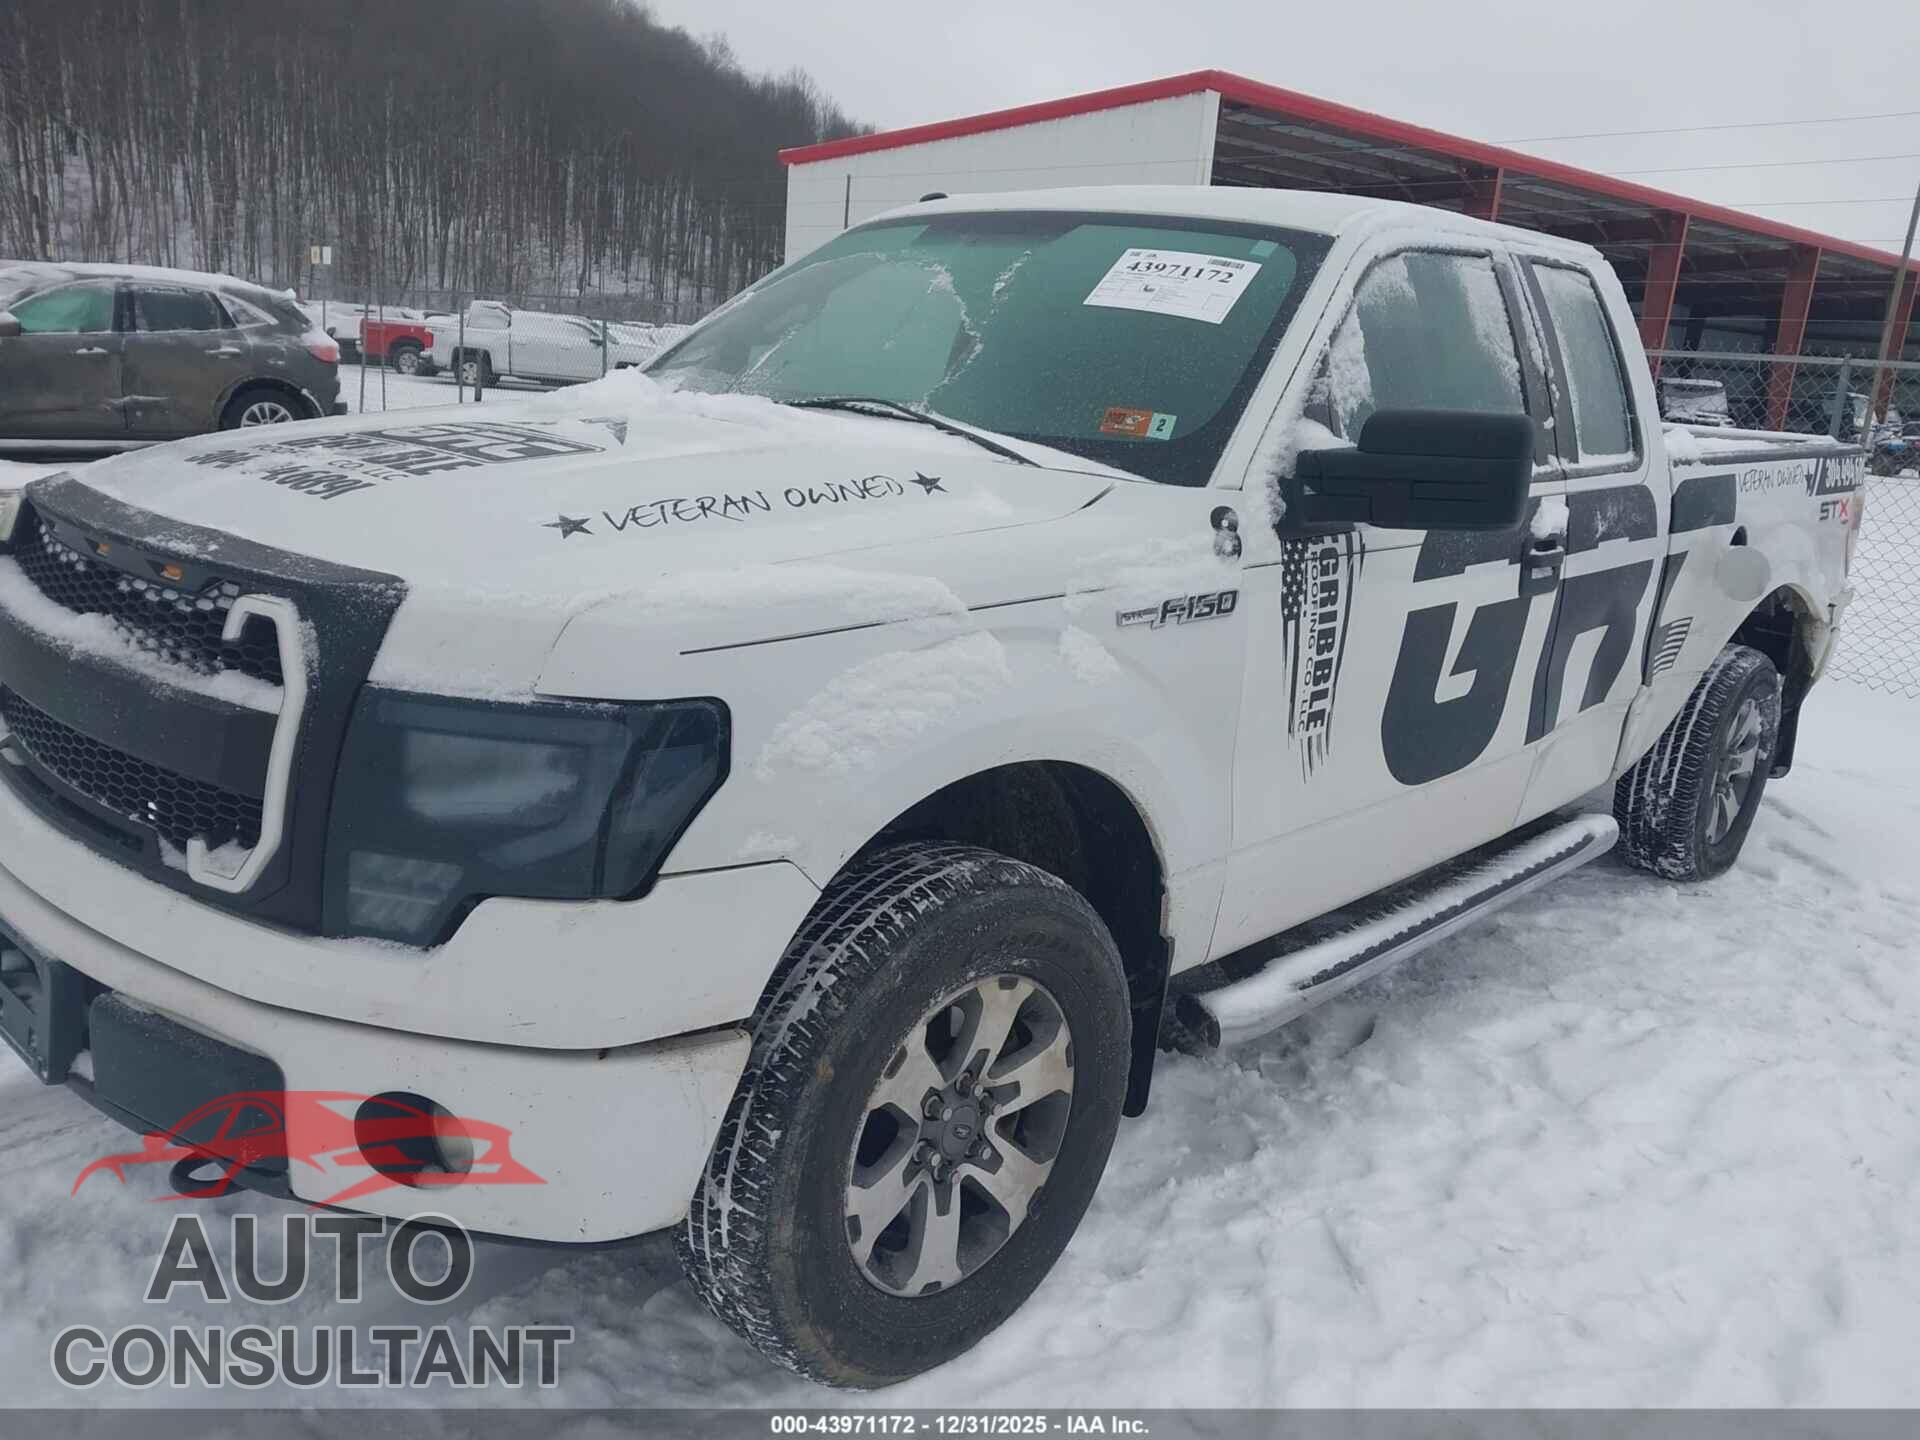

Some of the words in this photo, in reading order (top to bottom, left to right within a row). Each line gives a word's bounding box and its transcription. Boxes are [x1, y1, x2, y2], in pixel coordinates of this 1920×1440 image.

[1126, 261, 1234, 284] 43971172
[1156, 418, 1168, 432] 2
[277, 434, 484, 476] GRIBLE
[362, 468, 408, 480] LLC
[1738, 468, 1774, 495] VETERAN
[602, 489, 772, 532] VETERAN
[783, 475, 904, 508] OWNED
[1819, 500, 1849, 522] STX
[1159, 589, 1239, 624] F-150
[1307, 550, 1320, 650] ROOFING
[1305, 546, 1340, 732] GRIBBLE
[1298, 698, 1309, 732] LLC
